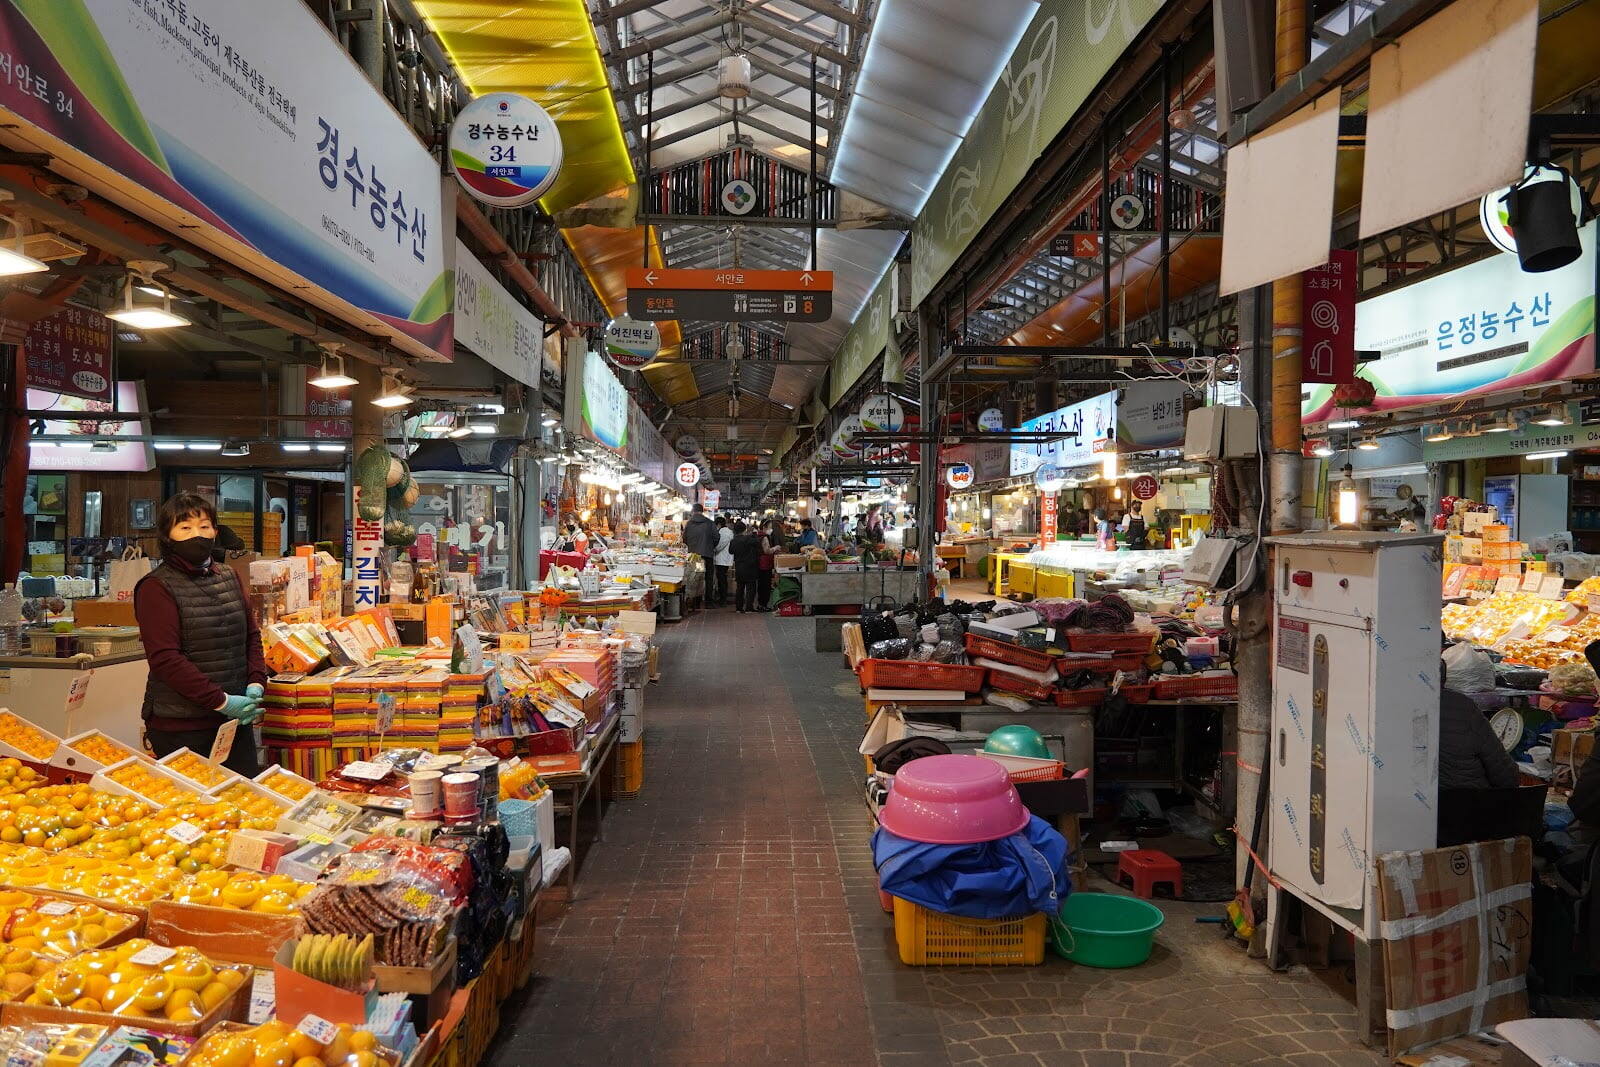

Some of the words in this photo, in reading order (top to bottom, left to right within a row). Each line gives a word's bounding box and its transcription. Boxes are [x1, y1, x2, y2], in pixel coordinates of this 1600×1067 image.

[223, 45, 266, 97] 제주특산물
[0, 51, 49, 101] 서안로
[56, 90, 75, 119] 34
[222, 71, 247, 100] products
[468, 123, 539, 141] 경수농수산
[489, 145, 516, 162] 34
[490, 167, 516, 176] 서안로
[316, 116, 427, 263] 경수농수산
[1309, 262, 1342, 275] 화전
[715, 273, 745, 285] 서안로
[1307, 277, 1342, 290] 소화기
[646, 297, 675, 309] 동안로
[804, 301, 813, 314] 8
[1436, 291, 1552, 351] 은정농수산
[611, 327, 653, 340] 여진떡집
[72, 347, 103, 369] 도소매
[1135, 478, 1155, 498] 쌀
